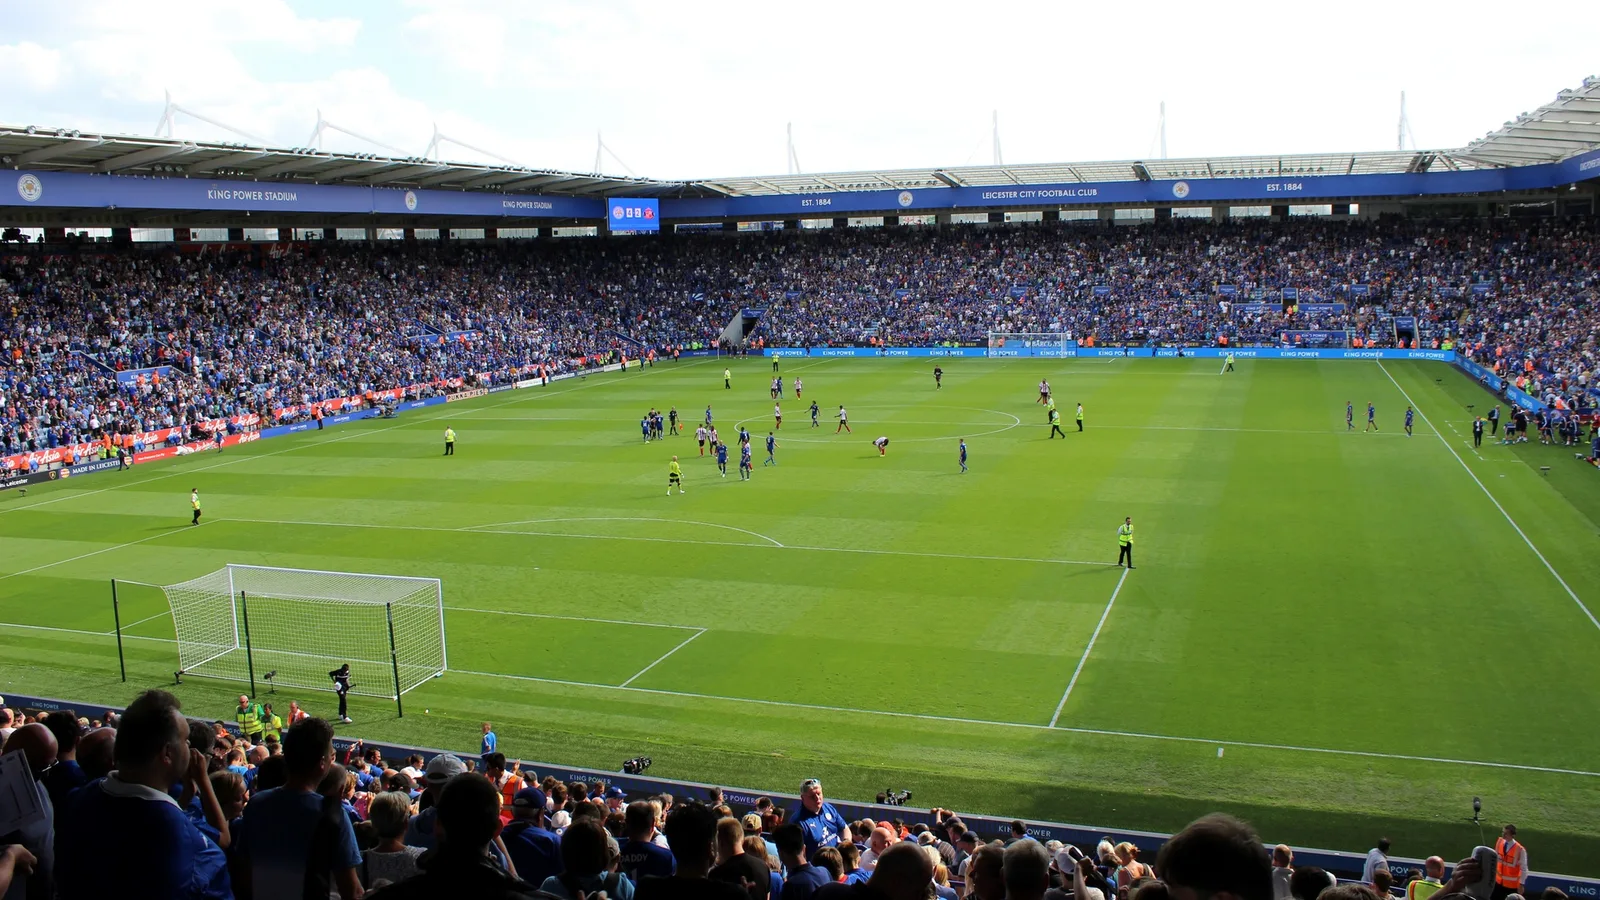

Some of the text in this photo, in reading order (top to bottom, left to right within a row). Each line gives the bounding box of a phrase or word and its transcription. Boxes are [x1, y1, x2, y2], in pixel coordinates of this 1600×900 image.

[1267, 183, 1281, 191] EST.
[207, 189, 298, 201] KING POWER STADIUM
[982, 191, 1017, 199] LEICESTER
[1020, 190, 1036, 198] CITY
[1038, 189, 1076, 197] FOOTBALL
[516, 201, 533, 209] POWER
[815, 198, 831, 206] 1884
[447, 389, 484, 400] PUKKA PIES
[237, 413, 260, 426] AirAsia
[239, 431, 260, 444] AirAsia
[28, 450, 60, 464] AirAsia
[72, 466, 88, 475] MADE
[588, 776, 611, 784] POWER
[730, 795, 756, 803] POWER
[998, 825, 1051, 837] KIN OWER
[1569, 885, 1596, 896] KING
